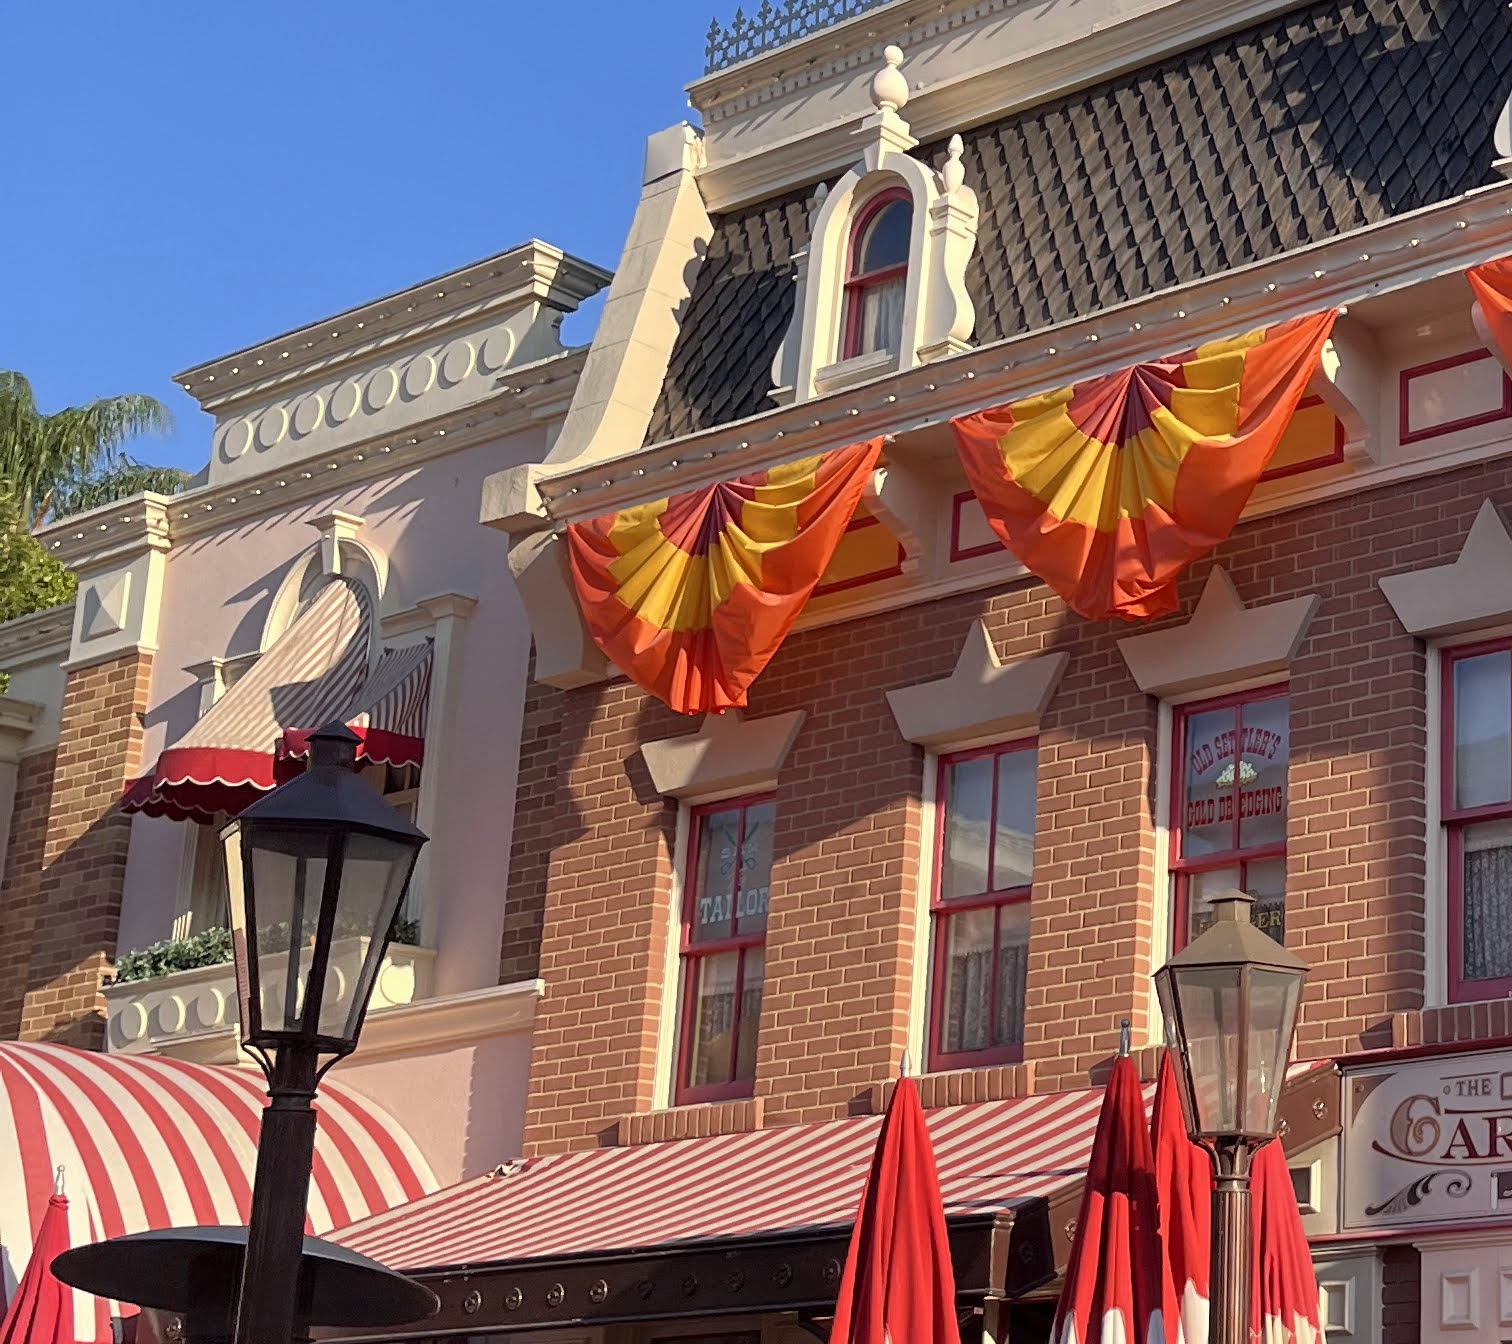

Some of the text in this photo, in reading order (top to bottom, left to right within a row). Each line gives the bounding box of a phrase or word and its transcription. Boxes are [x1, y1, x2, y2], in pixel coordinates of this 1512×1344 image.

[1192, 743, 1214, 775] OLD
[1187, 785, 1283, 828] GOLD DREDGING
[701, 886, 769, 925] TAILOR
[1455, 1077, 1492, 1098] THE
